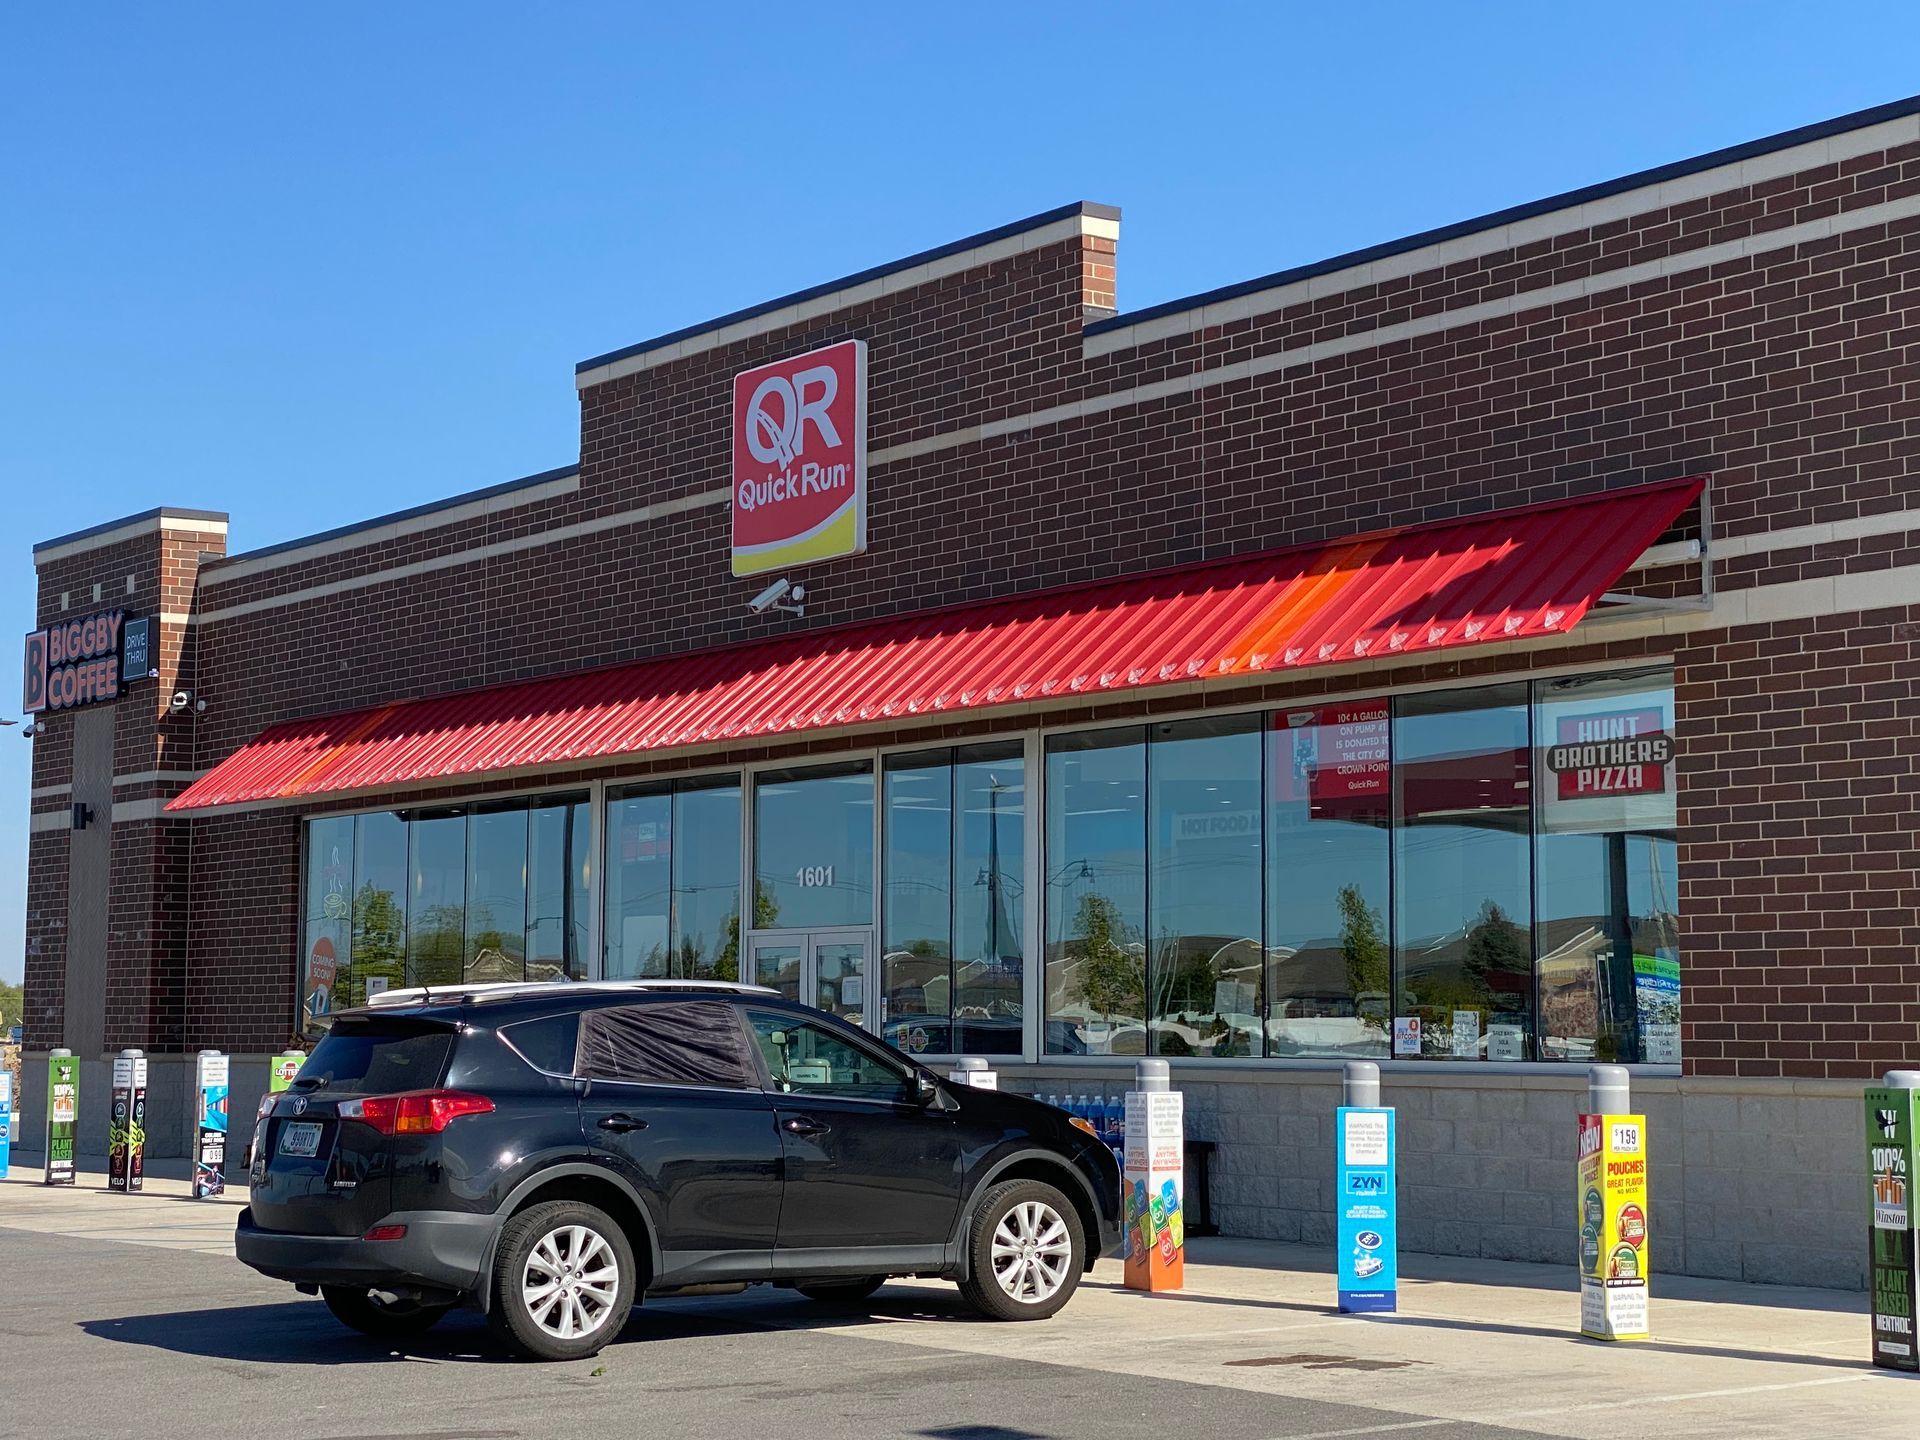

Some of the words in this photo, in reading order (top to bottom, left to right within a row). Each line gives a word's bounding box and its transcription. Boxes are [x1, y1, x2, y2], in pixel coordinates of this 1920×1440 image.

[746, 366, 842, 472] QR
[739, 469, 799, 512] Quick
[50, 611, 123, 665] BIGGBY
[127, 633, 146, 648] DRIVE
[127, 650, 146, 664] THRU
[48, 656, 119, 707] COFFEE
[1337, 713, 1351, 724] 10¢
[1352, 712, 1359, 722] A
[1340, 726, 1353, 736] ON
[1355, 724, 1376, 734] PUMP
[1579, 717, 1639, 742] HUNT
[1336, 740, 1343, 749] IS
[1345, 738, 1380, 748] DONATED
[1342, 752, 1356, 761] THE
[1357, 750, 1373, 760] CITY
[1375, 749, 1386, 758] OF
[1554, 740, 1668, 769] BROTHERS
[1337, 764, 1366, 775] CROWN
[1348, 781, 1366, 790] Quick
[1366, 780, 1380, 788] Run
[1577, 765, 1643, 792] PIZZA
[797, 866, 832, 887] 1601
[312, 954, 335, 968] COMING
[53, 1084, 74, 1095] 100%
[52, 1140, 73, 1150] PLANT
[1580, 1125, 1601, 1157] NEW
[51, 1150, 73, 1161] BASED
[1872, 1148, 1906, 1172] 100%
[1607, 1160, 1644, 1176] POUCHES
[110, 1178, 125, 1186] VELO
[132, 1177, 142, 1185] VELO
[1352, 1177, 1382, 1189] ZYN
[1607, 1179, 1624, 1188] GREAT
[1875, 1209, 1906, 1225] Winston
[1875, 1267, 1908, 1293] PLANT
[1876, 1290, 1910, 1316] BASED
